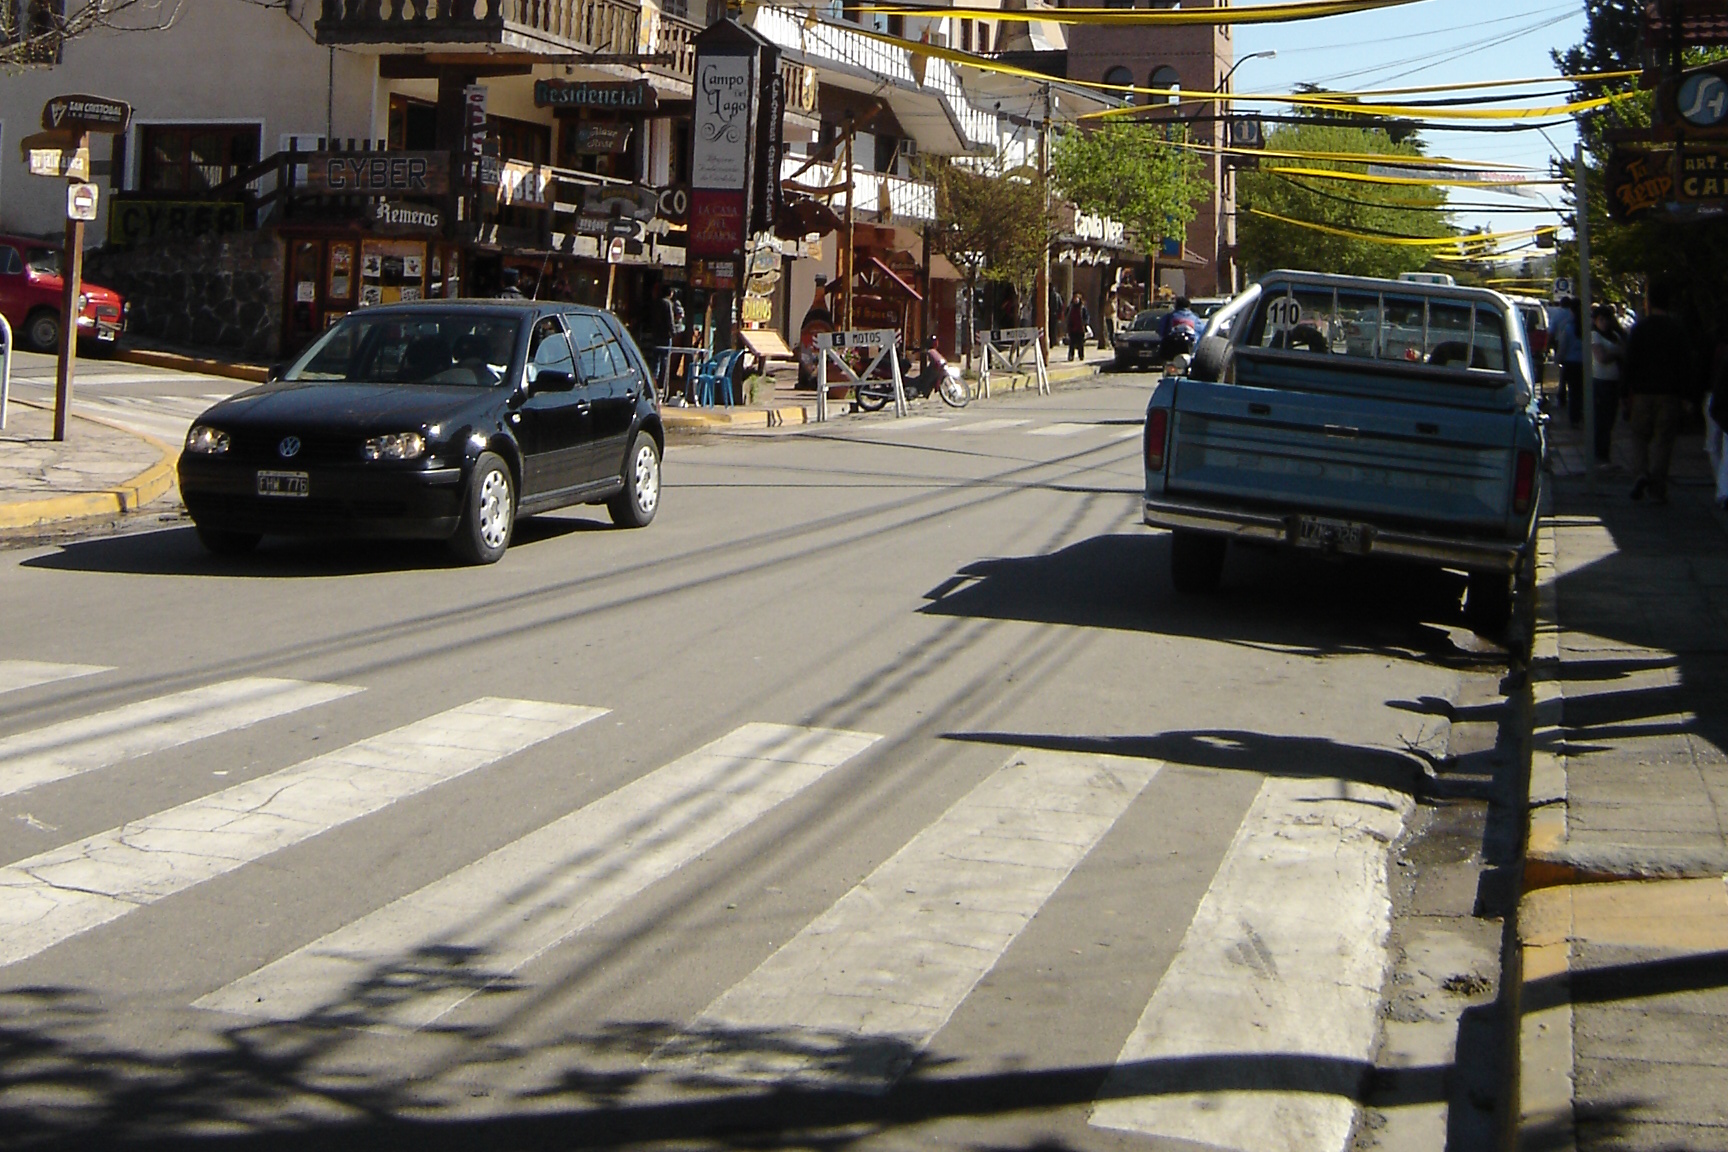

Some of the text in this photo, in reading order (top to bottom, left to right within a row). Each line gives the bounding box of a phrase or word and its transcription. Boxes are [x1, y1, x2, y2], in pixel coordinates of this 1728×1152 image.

[702, 64, 744, 95] Campo
[536, 84, 643, 105] Residencial
[328, 158, 427, 189] CYBER
[501, 170, 545, 203] YBER
[377, 202, 438, 227] Remeras
[1270, 302, 1299, 324] 110
[852, 332, 881, 344] MOTOS
